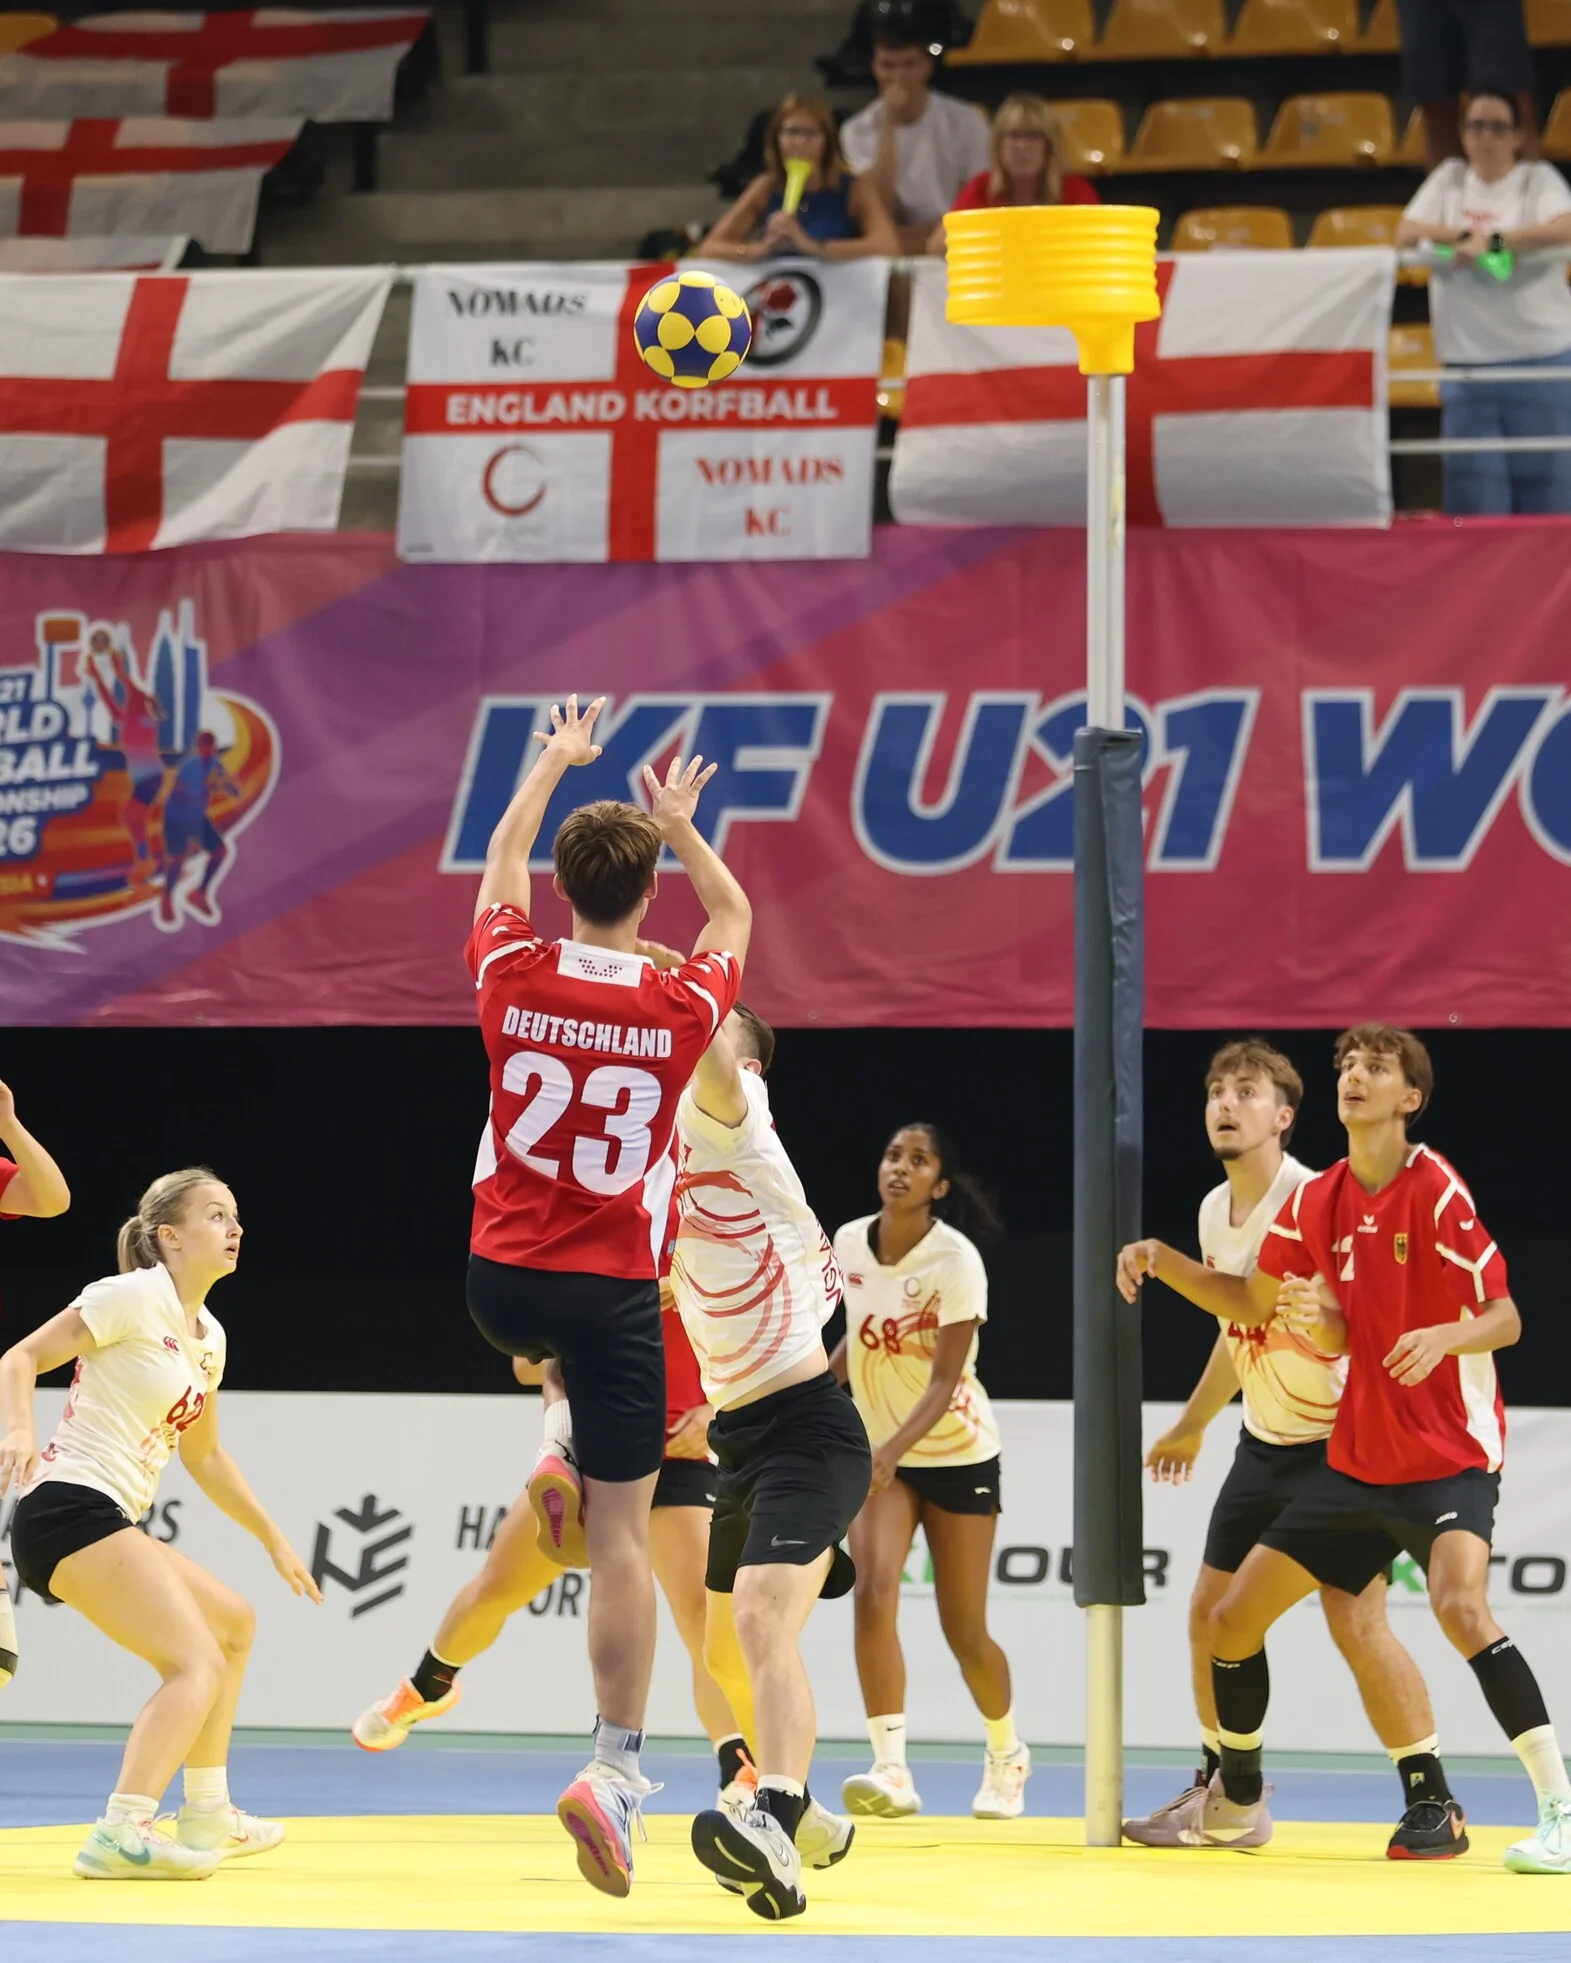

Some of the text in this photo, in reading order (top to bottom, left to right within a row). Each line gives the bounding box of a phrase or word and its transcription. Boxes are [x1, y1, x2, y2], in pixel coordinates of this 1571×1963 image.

[447, 289, 587, 318] NOMADS
[490, 338, 537, 367] KC
[446, 387, 839, 425] ENGLAND KORFBALL
[694, 455, 845, 487] NOMADS
[744, 508, 791, 537] KC
[0, 703, 64, 744] LD
[437, 692, 833, 874] IKF
[1301, 684, 1571, 874] W
[501, 1005, 673, 1059] DEUTSCHLAND
[501, 1050, 663, 1197] 23
